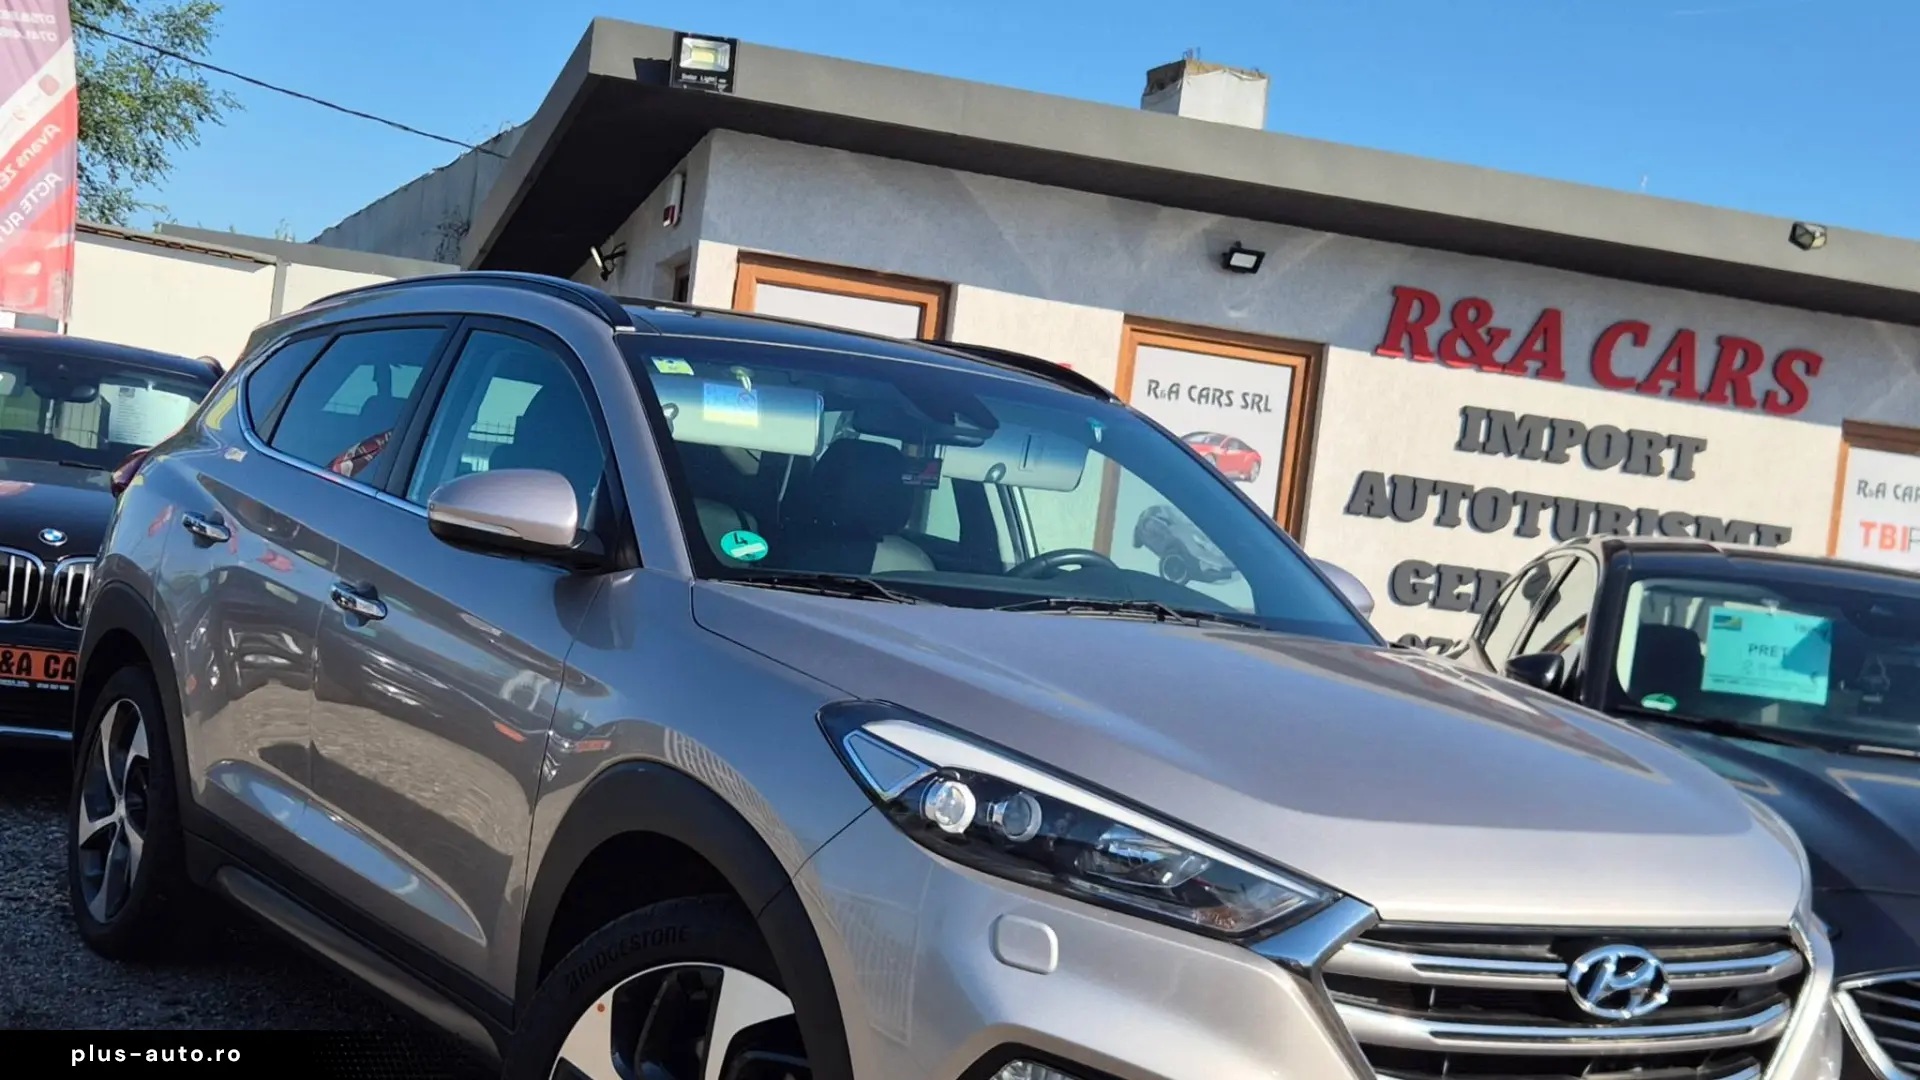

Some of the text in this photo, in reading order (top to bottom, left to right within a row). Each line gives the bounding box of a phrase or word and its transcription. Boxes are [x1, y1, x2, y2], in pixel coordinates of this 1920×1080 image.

[1375, 286, 1823, 415] R&A CARS
[1187, 384, 1235, 408] CARS
[1240, 391, 1272, 414] SRL
[1454, 405, 1707, 481] IMPORT
[565, 925, 690, 994] BRIDGESTONE
